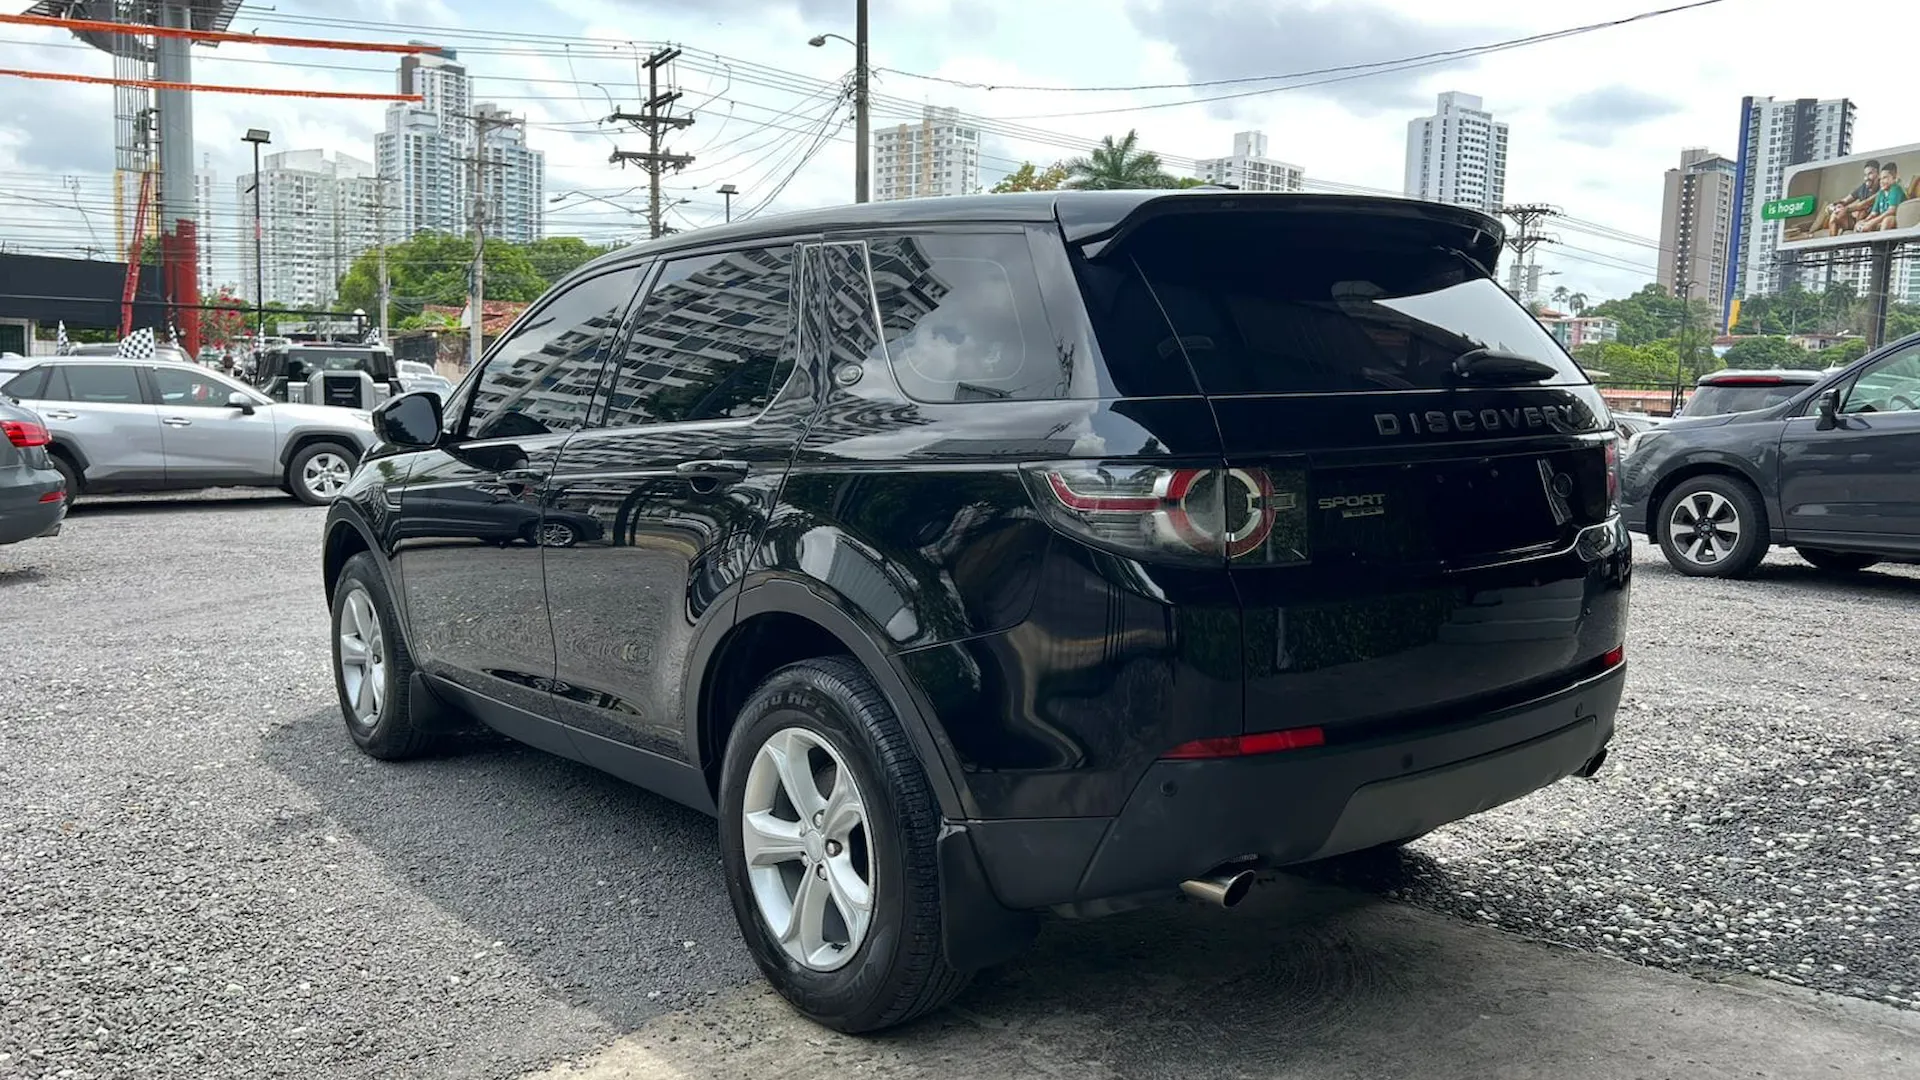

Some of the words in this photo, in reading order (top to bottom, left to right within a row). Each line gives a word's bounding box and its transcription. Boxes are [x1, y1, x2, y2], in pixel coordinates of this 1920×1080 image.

[1778, 202, 1805, 215] hogar
[1374, 404, 1574, 435] DISCOVERY
[1318, 493, 1386, 510] SPORT
